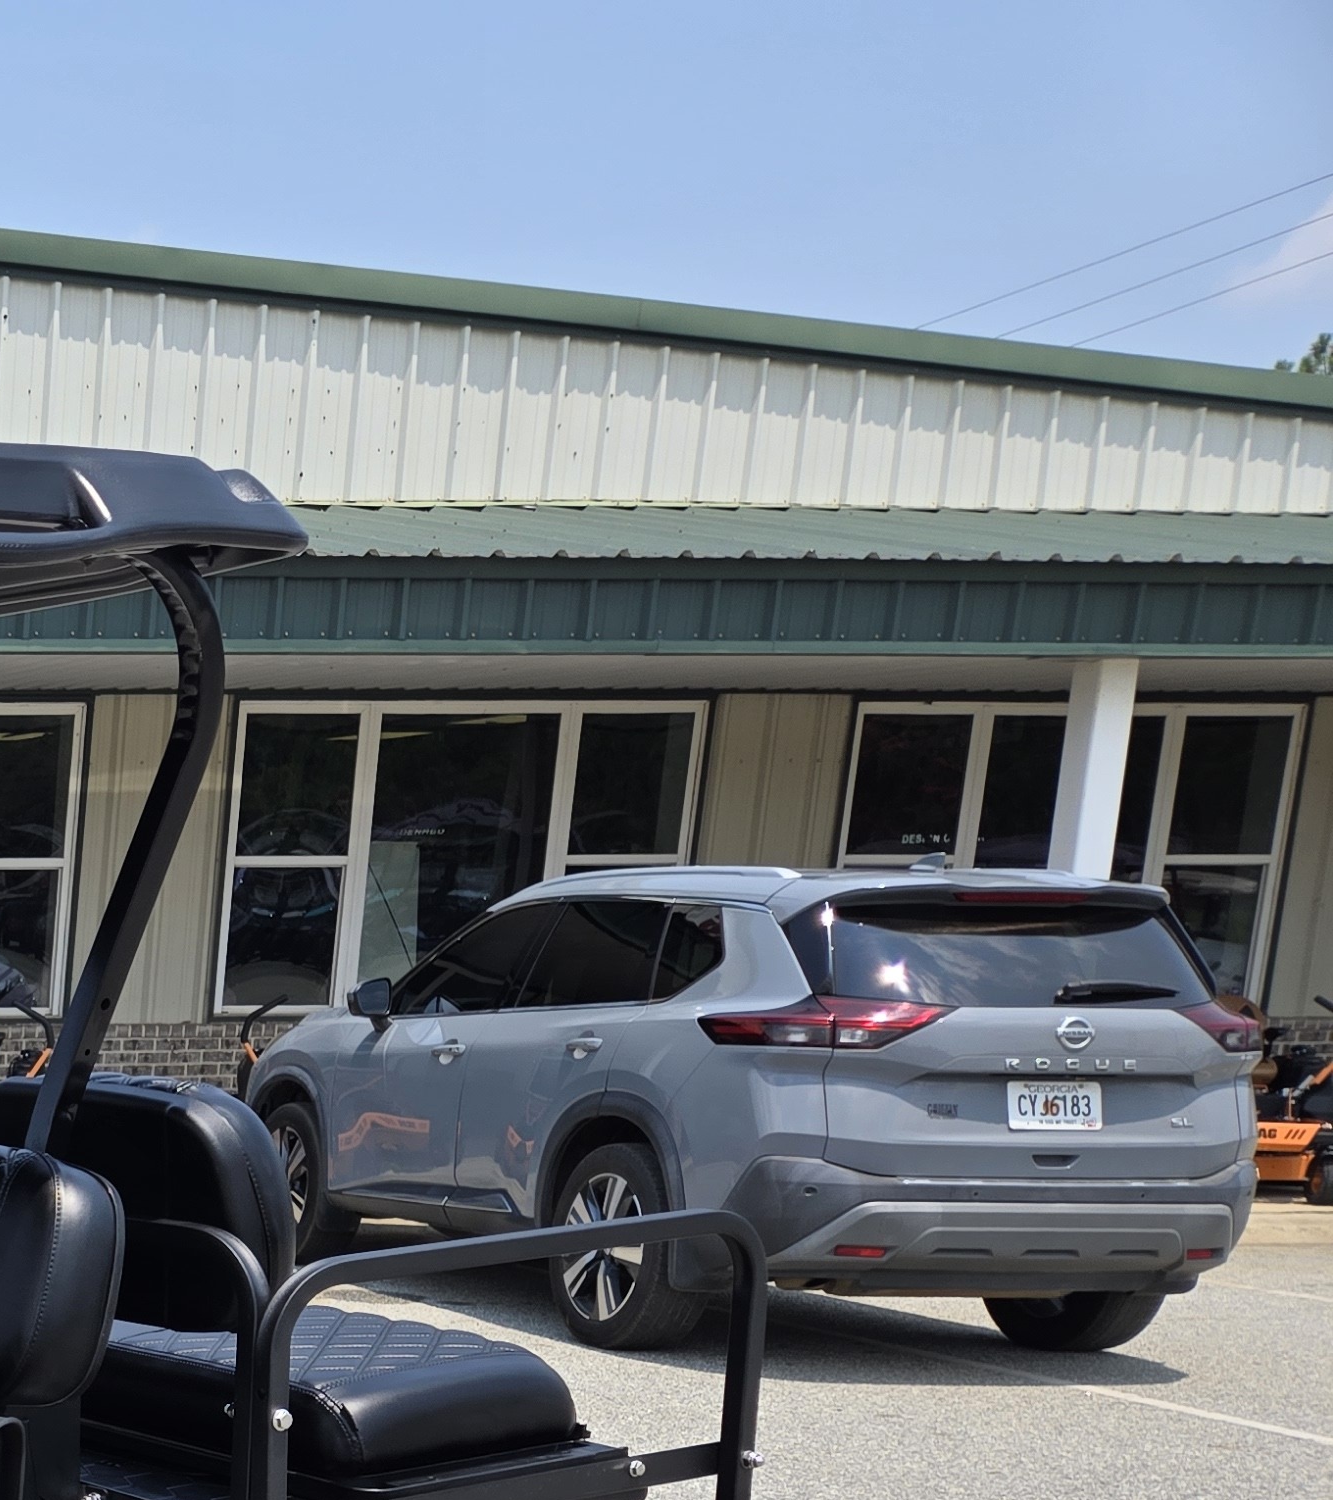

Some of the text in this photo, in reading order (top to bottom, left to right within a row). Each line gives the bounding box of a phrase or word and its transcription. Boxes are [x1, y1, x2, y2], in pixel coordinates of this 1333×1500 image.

[1005, 1058, 1137, 1070] ROGUE
[1028, 1085, 1078, 1093] GEORGIA
[1018, 1094, 1091, 1117] CYJ6183
[1171, 1117, 1194, 1128] SL
